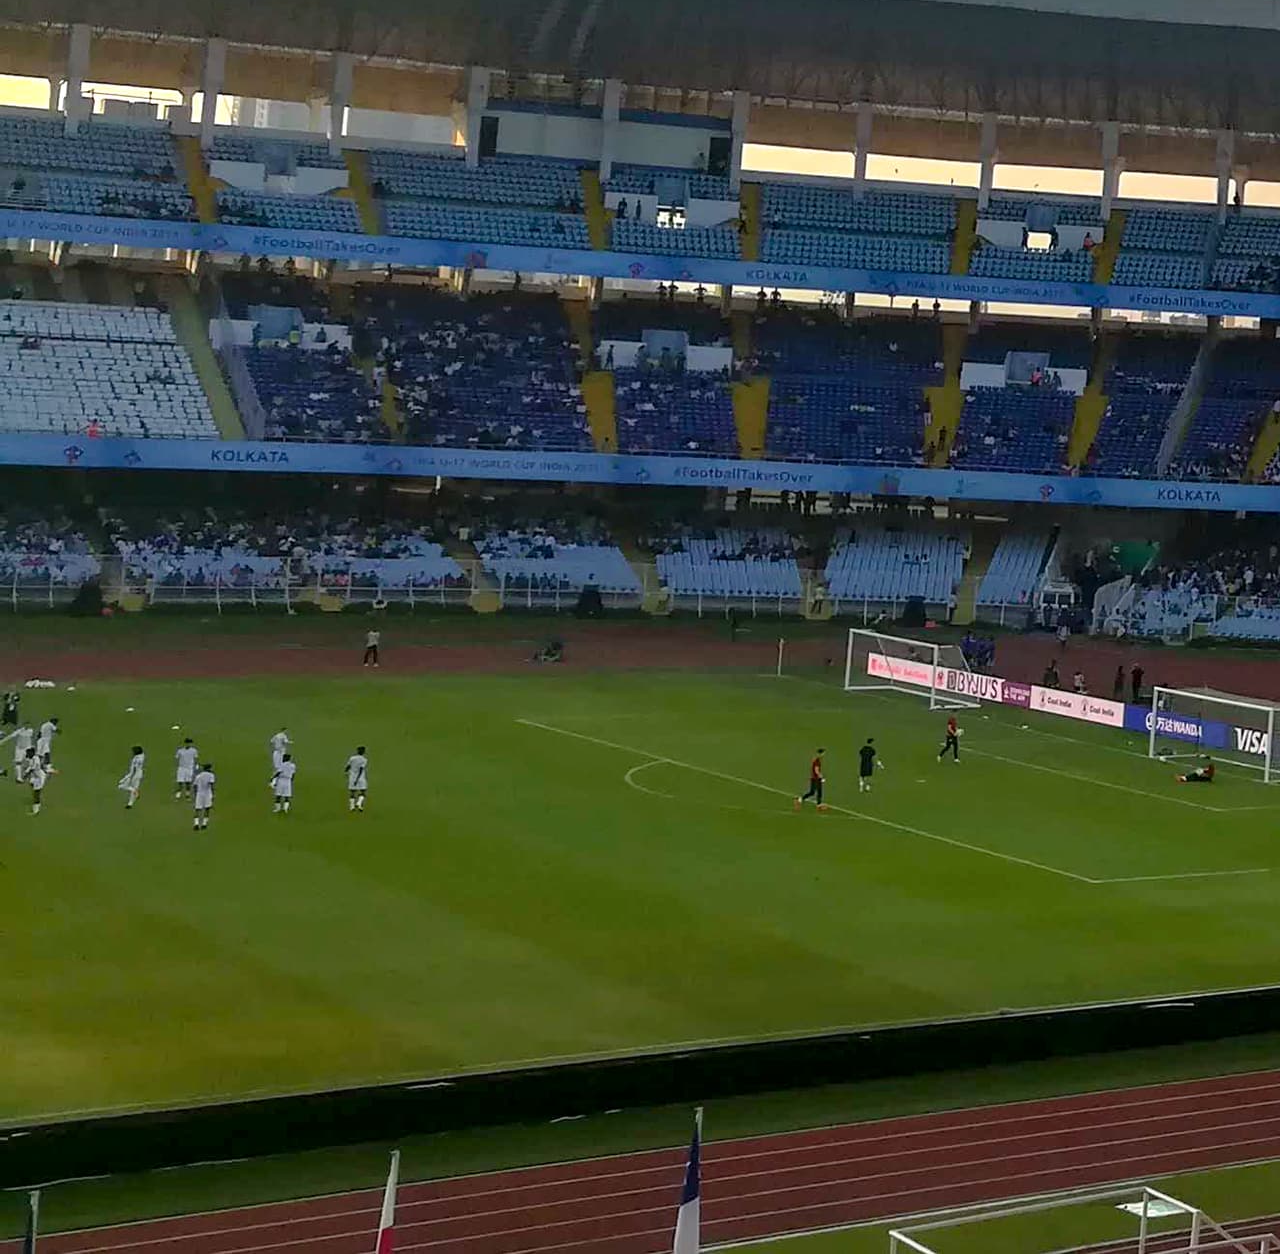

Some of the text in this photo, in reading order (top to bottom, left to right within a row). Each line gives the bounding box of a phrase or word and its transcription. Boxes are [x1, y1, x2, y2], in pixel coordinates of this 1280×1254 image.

[745, 269, 808, 282] KOLKATA
[211, 449, 289, 463] KOLKATA
[1158, 488, 1221, 502] KOLKATA
[958, 672, 998, 699] BYJU'S
[1233, 727, 1269, 755] VISA
